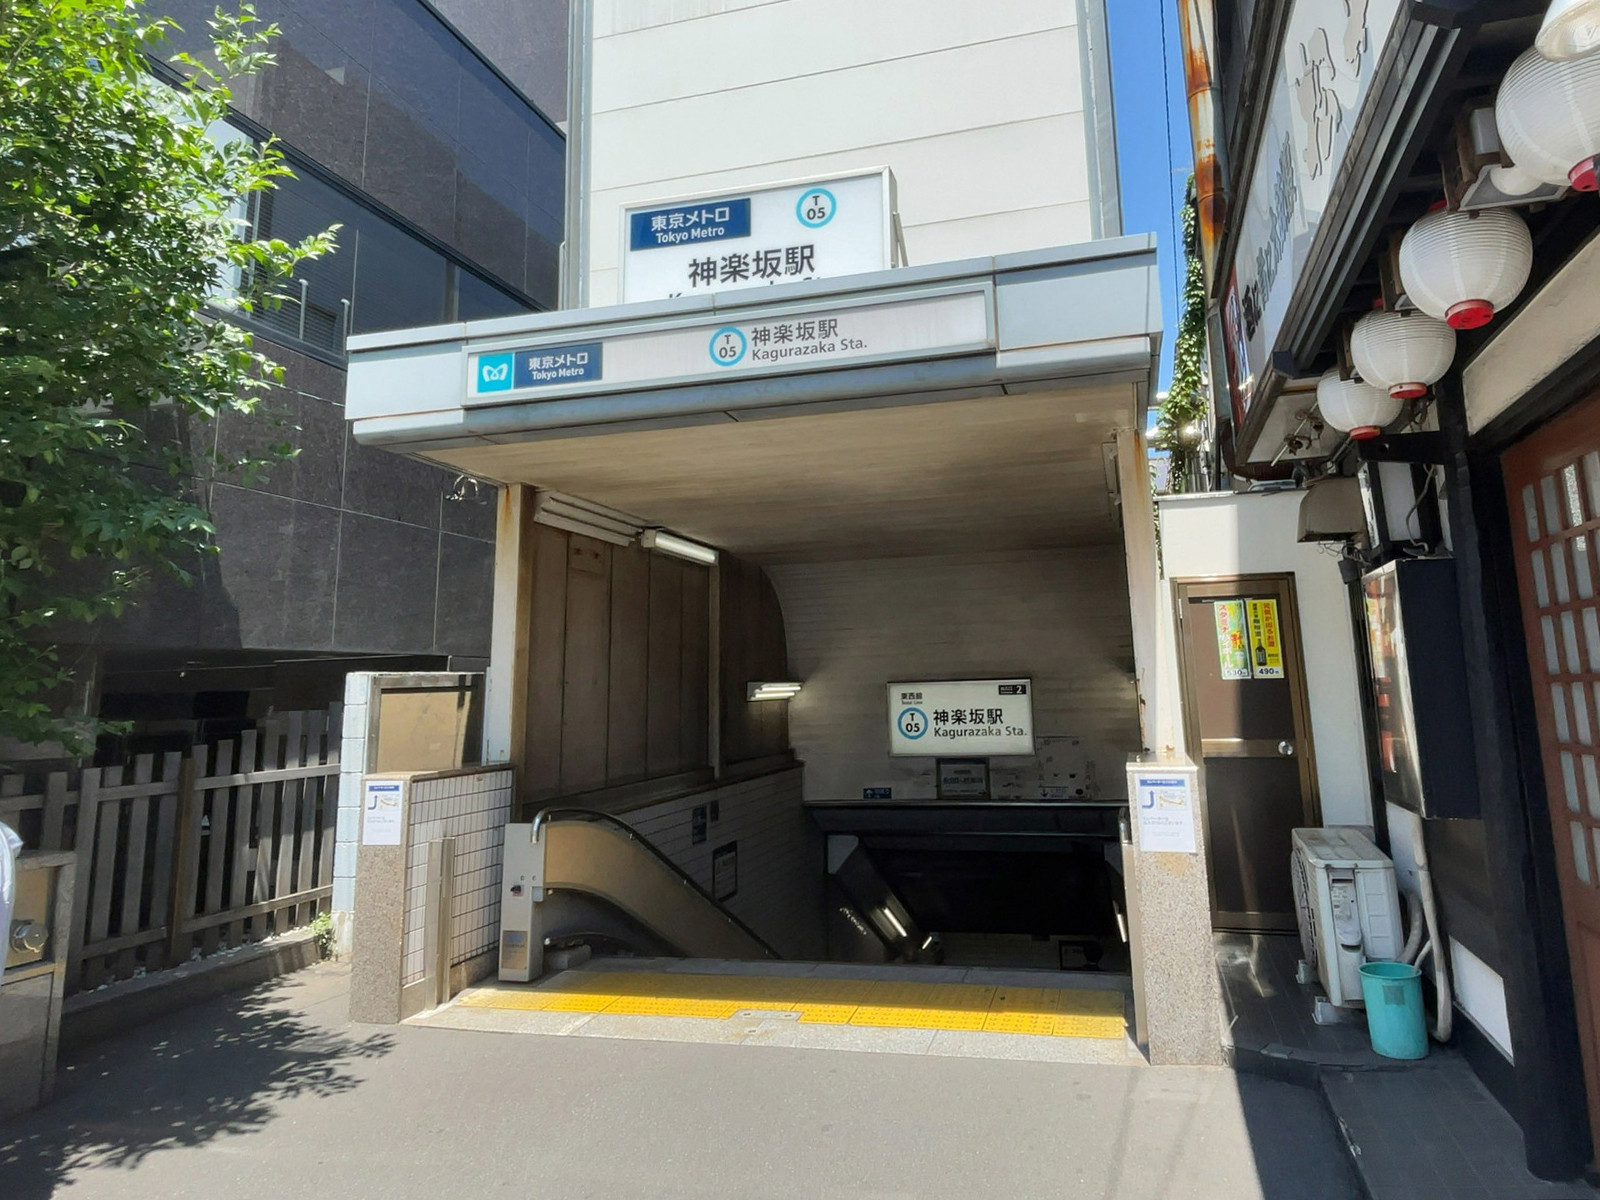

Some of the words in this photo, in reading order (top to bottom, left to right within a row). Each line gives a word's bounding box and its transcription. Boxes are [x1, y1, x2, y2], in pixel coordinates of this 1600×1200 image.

[812, 195, 820, 206] T
[651, 206, 730, 231] 東京メトロ
[807, 207, 826, 220] 05
[656, 230, 689, 244] Tokyo
[691, 226, 725, 240] Metro
[688, 244, 816, 288] 神楽坂駅
[724, 334, 732, 345] T
[751, 318, 840, 347] 神楽坂駅
[719, 346, 738, 359] 05
[752, 338, 837, 363] Kagurazaka
[840, 335, 868, 352] Sta.
[528, 351, 589, 371] 東京メトロ
[532, 368, 557, 381] Tokyo
[558, 365, 585, 379] Metro
[1015, 685, 1023, 694] 2
[909, 713, 916, 722] T
[933, 708, 1004, 726] 神楽坂駅
[905, 723, 920, 733] 05
[934, 726, 1002, 740] Kagurazaka
[1005, 725, 1028, 737] Sta.
